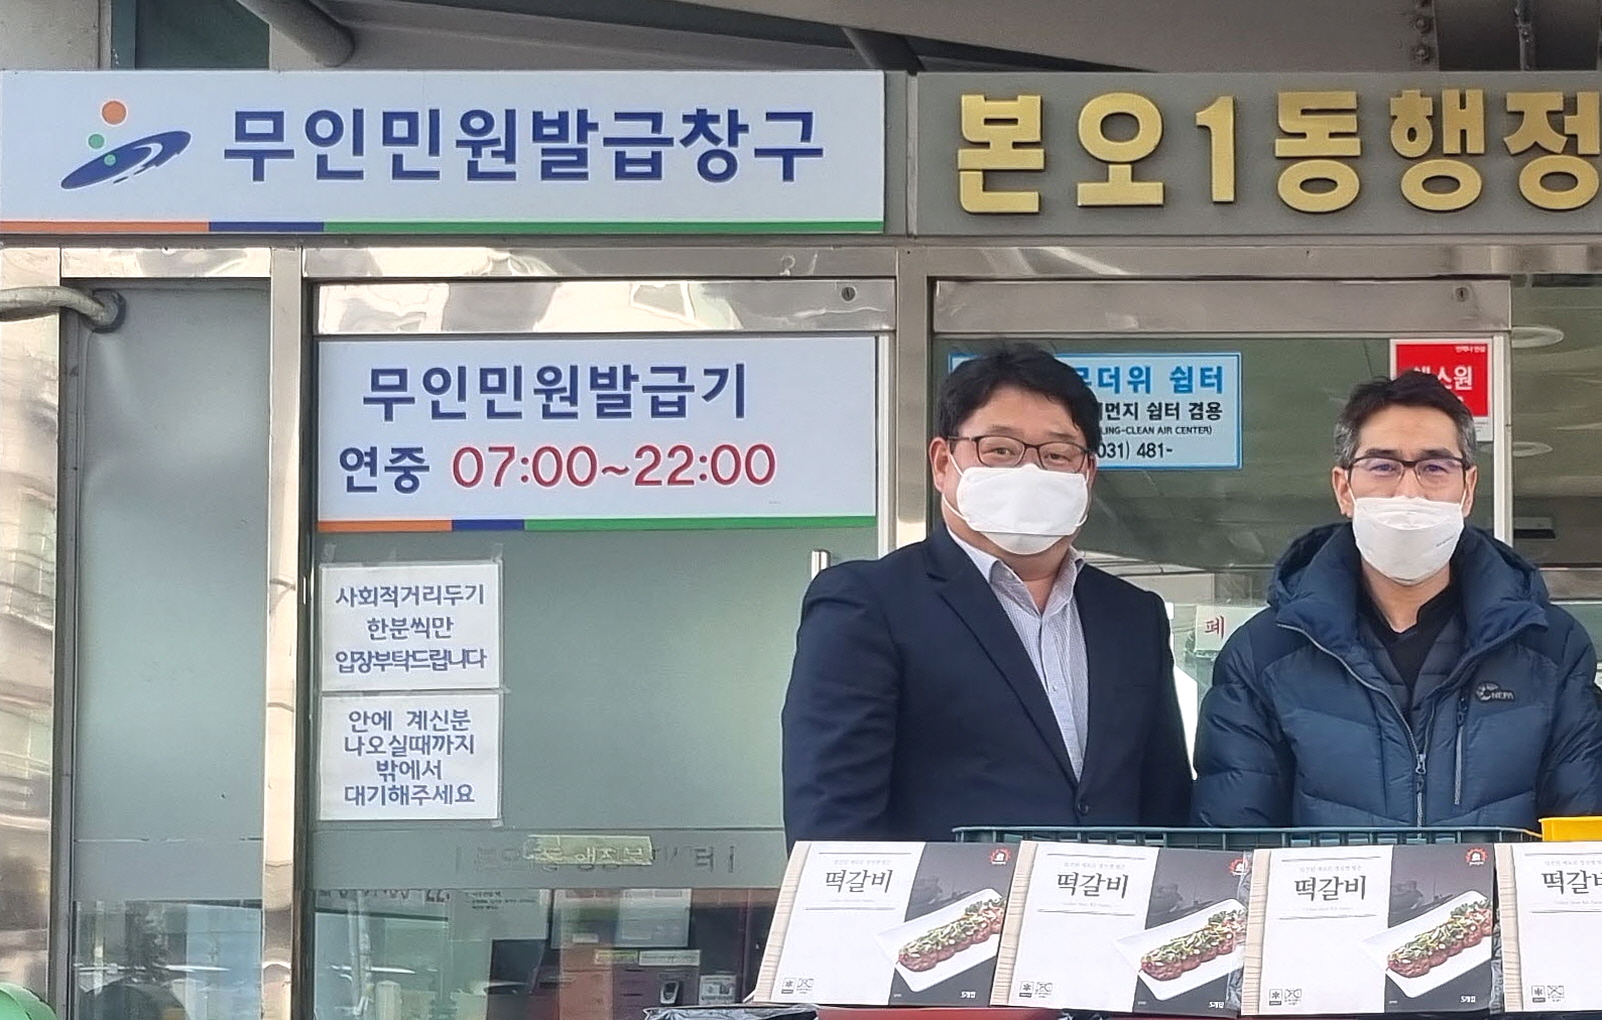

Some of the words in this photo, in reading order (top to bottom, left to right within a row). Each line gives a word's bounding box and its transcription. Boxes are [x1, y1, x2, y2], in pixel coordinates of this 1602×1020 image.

[223, 107, 825, 183] 무인민원발급창구
[1170, 366, 1223, 393] 쉼터
[1413, 365, 1473, 391] 스원
[362, 362, 749, 422] 무인민원발급기
[1100, 402, 1138, 420] 먼지
[1147, 402, 1180, 420] 쉼터
[1188, 402, 1223, 421] 겸용
[1157, 426, 1172, 435] AIR
[1175, 426, 1212, 435] CENTER)
[1136, 442, 1173, 458] 481-
[339, 444, 430, 494] 연중
[451, 443, 777, 488] 07:00~22:00
[335, 584, 485, 608] 사회적거리두기
[366, 616, 454, 641] 한분씩만
[335, 647, 488, 675] 입장부탁드립니다
[348, 710, 392, 733] 안에
[406, 709, 471, 732] 계신분
[344, 734, 475, 757] 나오실때까지
[376, 759, 442, 783] 밖에서
[344, 784, 475, 807] 대기해주세요
[825, 868, 893, 895] 떡갈비
[1056, 872, 1128, 899] 떡갈비
[1293, 875, 1367, 901] 떡갈비
